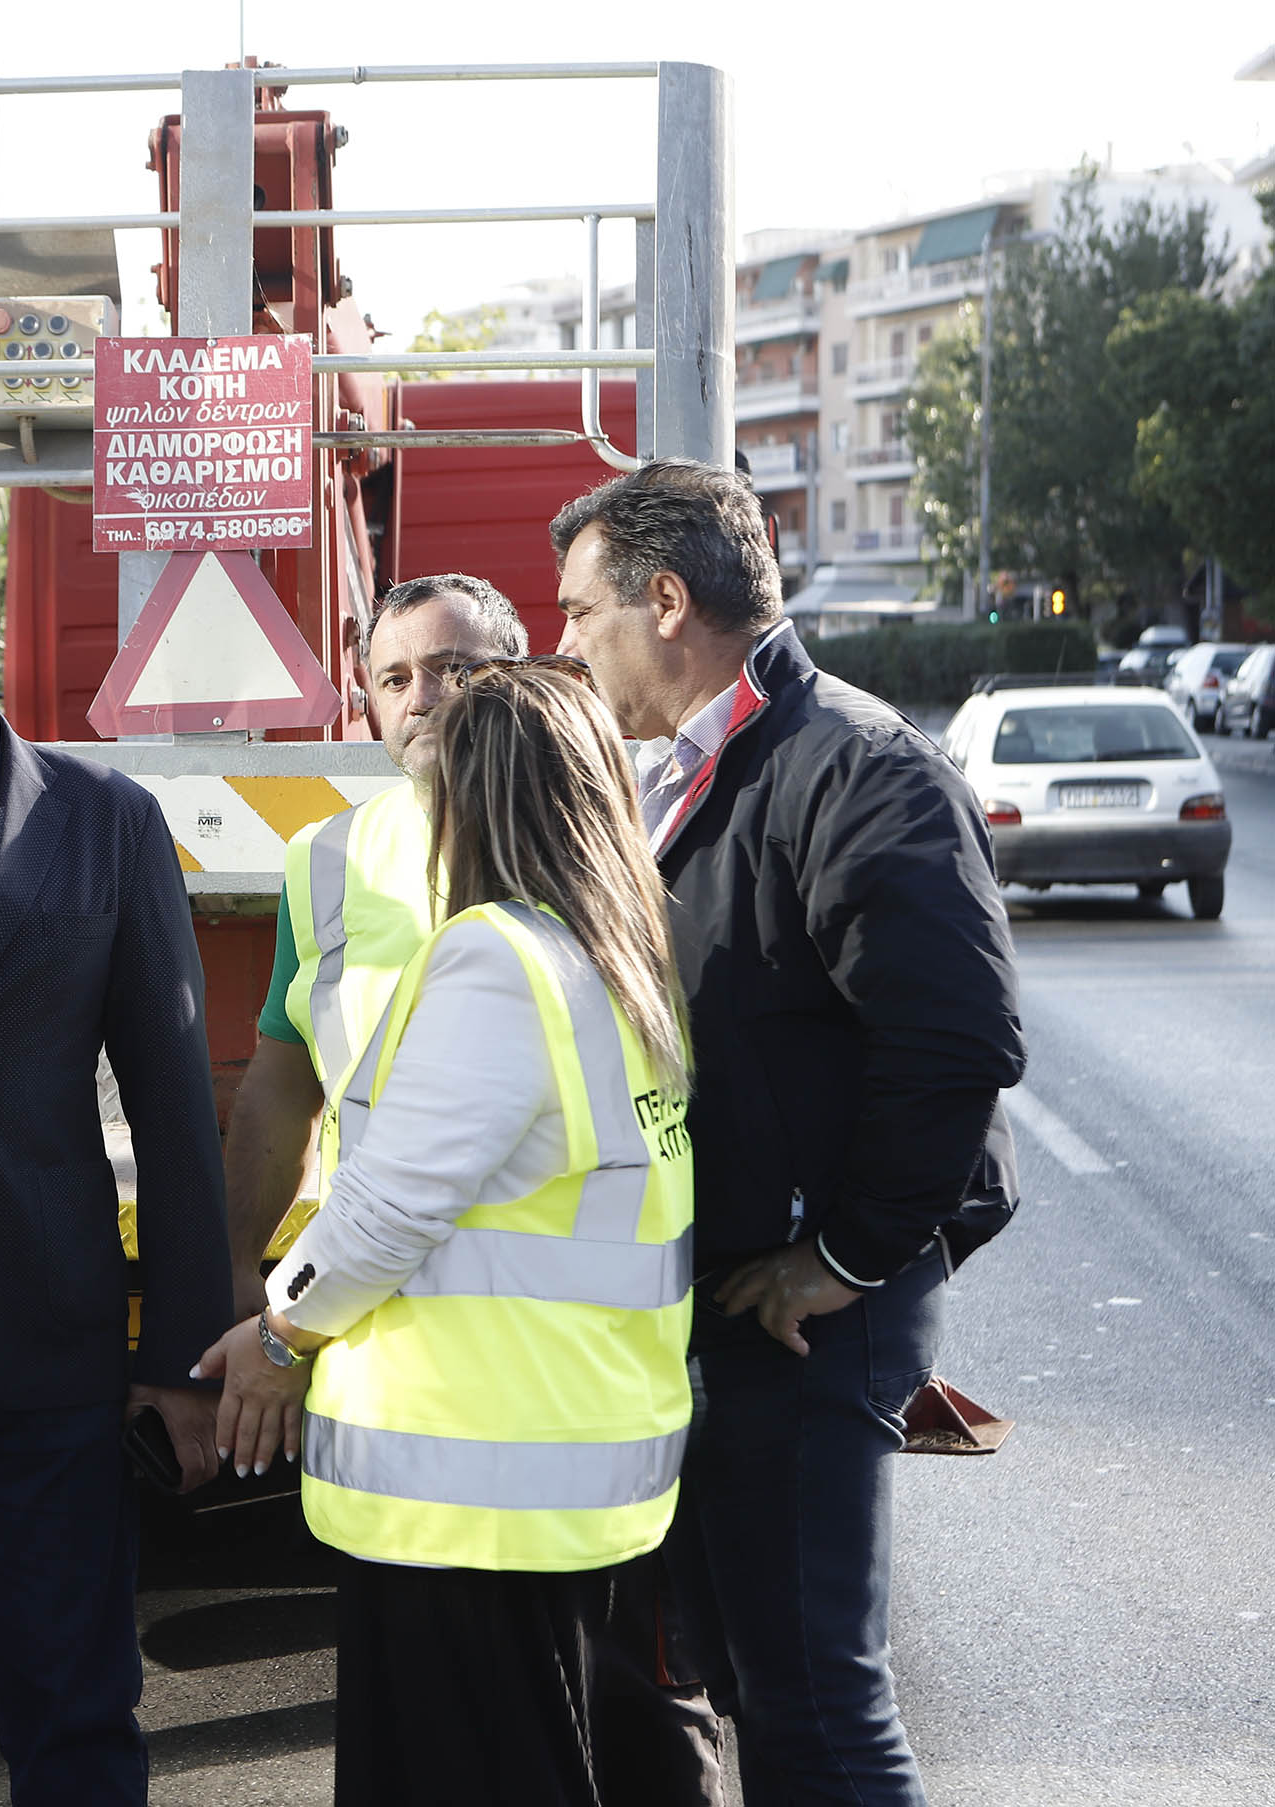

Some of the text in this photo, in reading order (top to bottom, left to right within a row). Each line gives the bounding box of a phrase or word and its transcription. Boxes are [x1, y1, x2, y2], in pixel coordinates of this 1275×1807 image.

[123, 345, 283, 373] ΚΛΑΔΕΜΑ
[159, 374, 246, 400] ΚΟΠΗ
[196, 400, 301, 425] δέντρων
[106, 429, 302, 458] ΔΙΑΜΟΡΦΩΣΗ
[106, 457, 302, 485] ΚΑΘΑΡΙΣΜΟΙ
[140, 486, 267, 509] οικοπέδων
[198, 816, 222, 826] MTS
